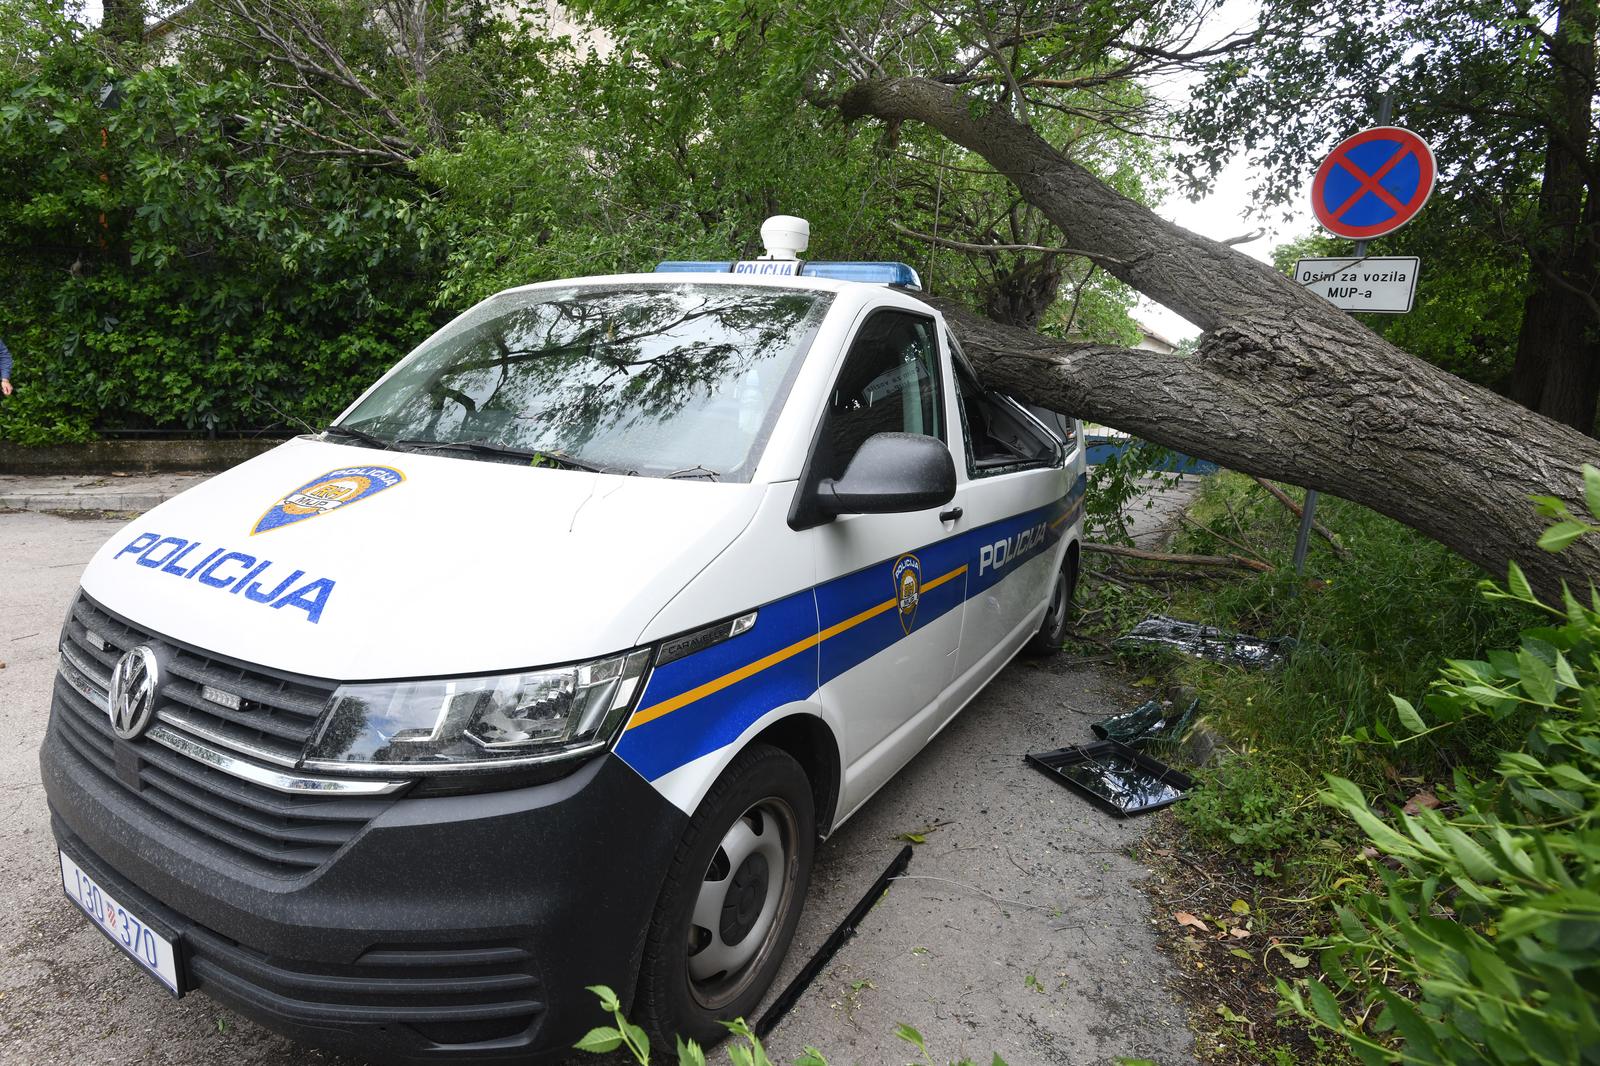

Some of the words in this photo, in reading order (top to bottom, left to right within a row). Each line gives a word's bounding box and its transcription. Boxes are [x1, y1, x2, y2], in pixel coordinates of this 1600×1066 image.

[1302, 271, 1335, 282] Osim
[1341, 273, 1357, 282] za
[1363, 271, 1406, 282] vozila
[1327, 287, 1372, 299] MUP-a
[329, 467, 399, 487] POLICIJA
[294, 496, 329, 507] MUP
[979, 521, 1047, 577] POLICIJA
[112, 532, 336, 625] POLICIJA
[895, 558, 919, 580] POLICIJA
[75, 868, 104, 924] 130
[118, 908, 158, 968] 370
